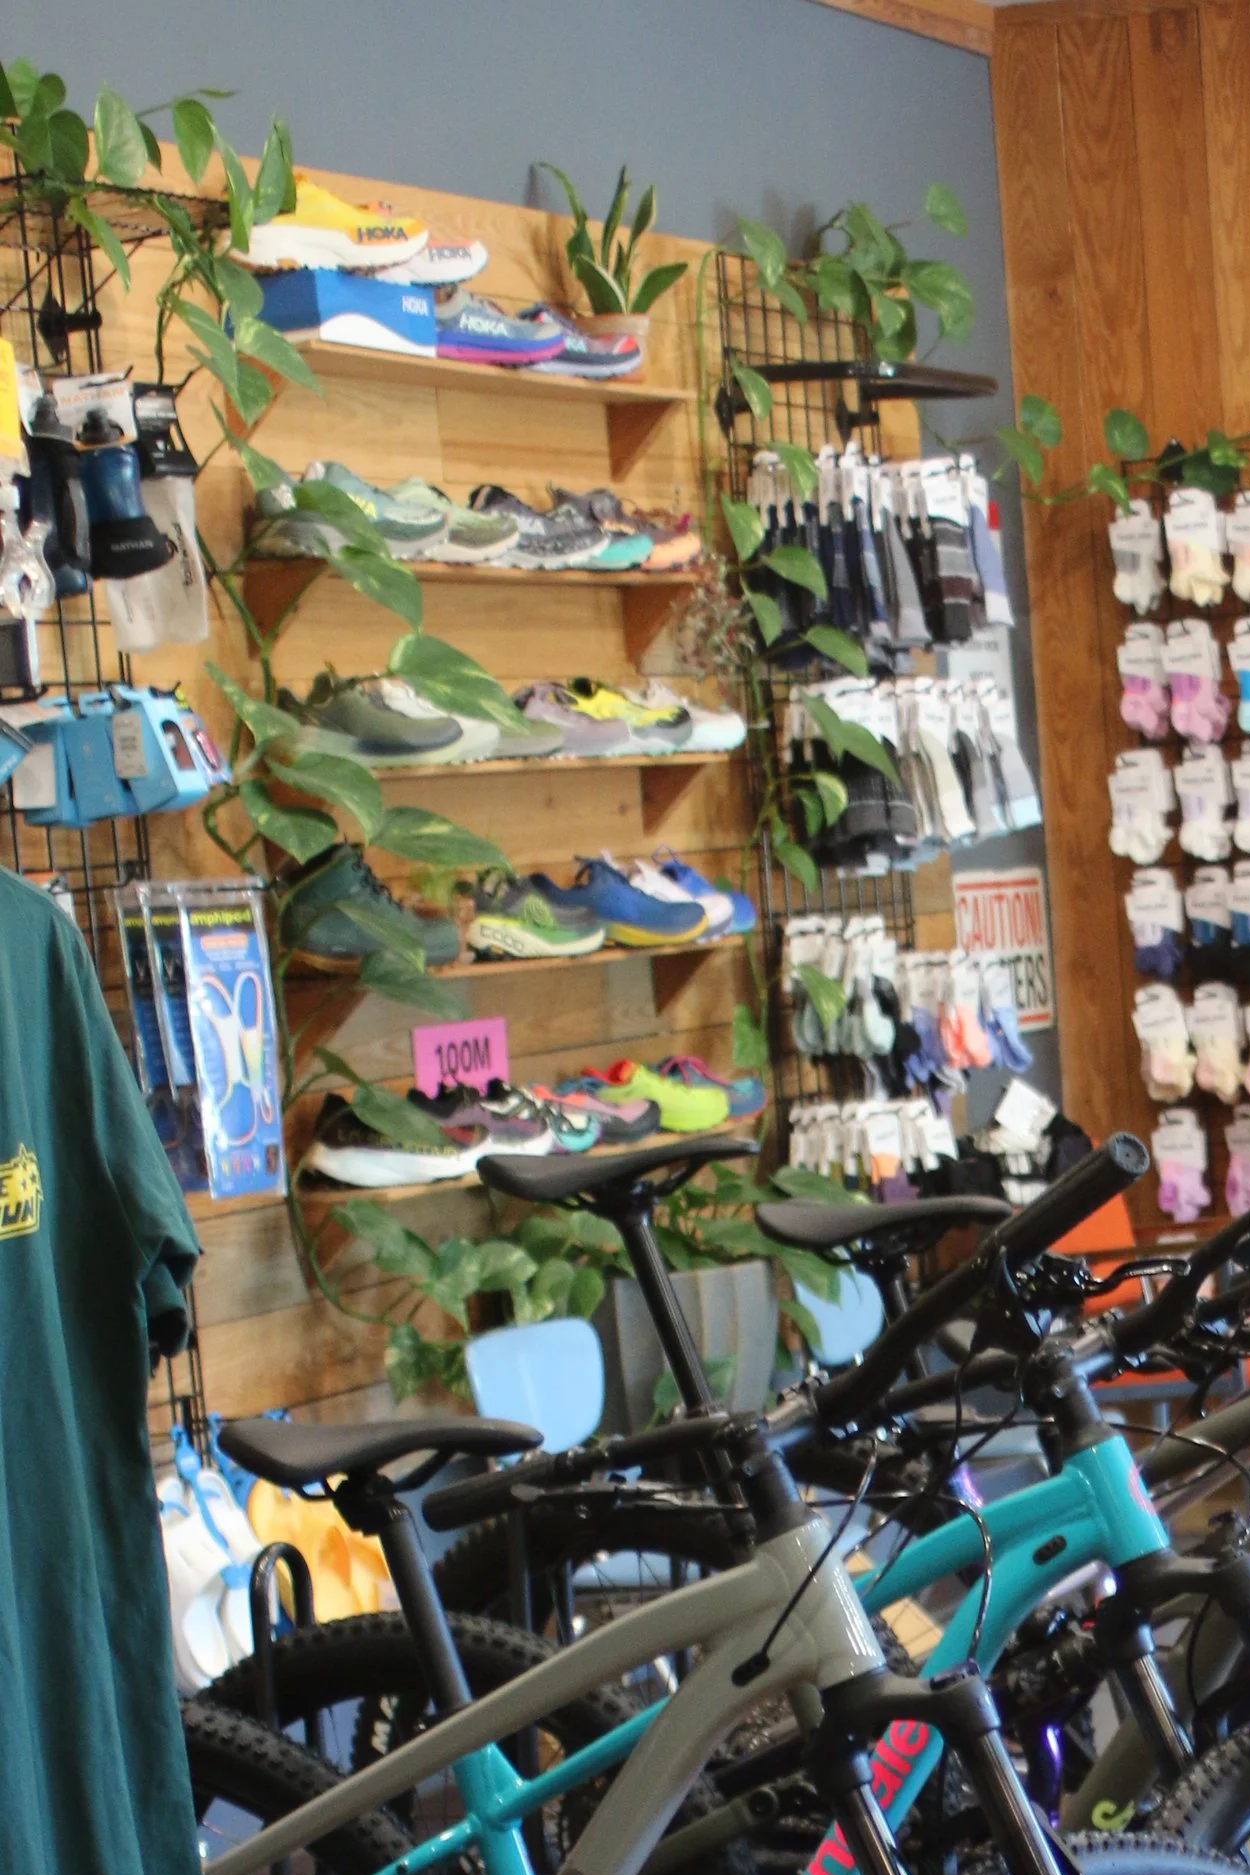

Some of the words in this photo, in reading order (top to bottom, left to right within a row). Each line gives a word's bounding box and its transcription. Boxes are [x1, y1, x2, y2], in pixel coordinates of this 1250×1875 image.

[356, 226, 409, 243] HOKA
[428, 246, 472, 262] HOKA
[401, 295, 429, 317] HOKA
[458, 313, 509, 337] HOKA
[110, 539, 155, 554] NATHAN
[956, 893, 1045, 955] CAUTION!
[434, 1036, 492, 1079] 100M
